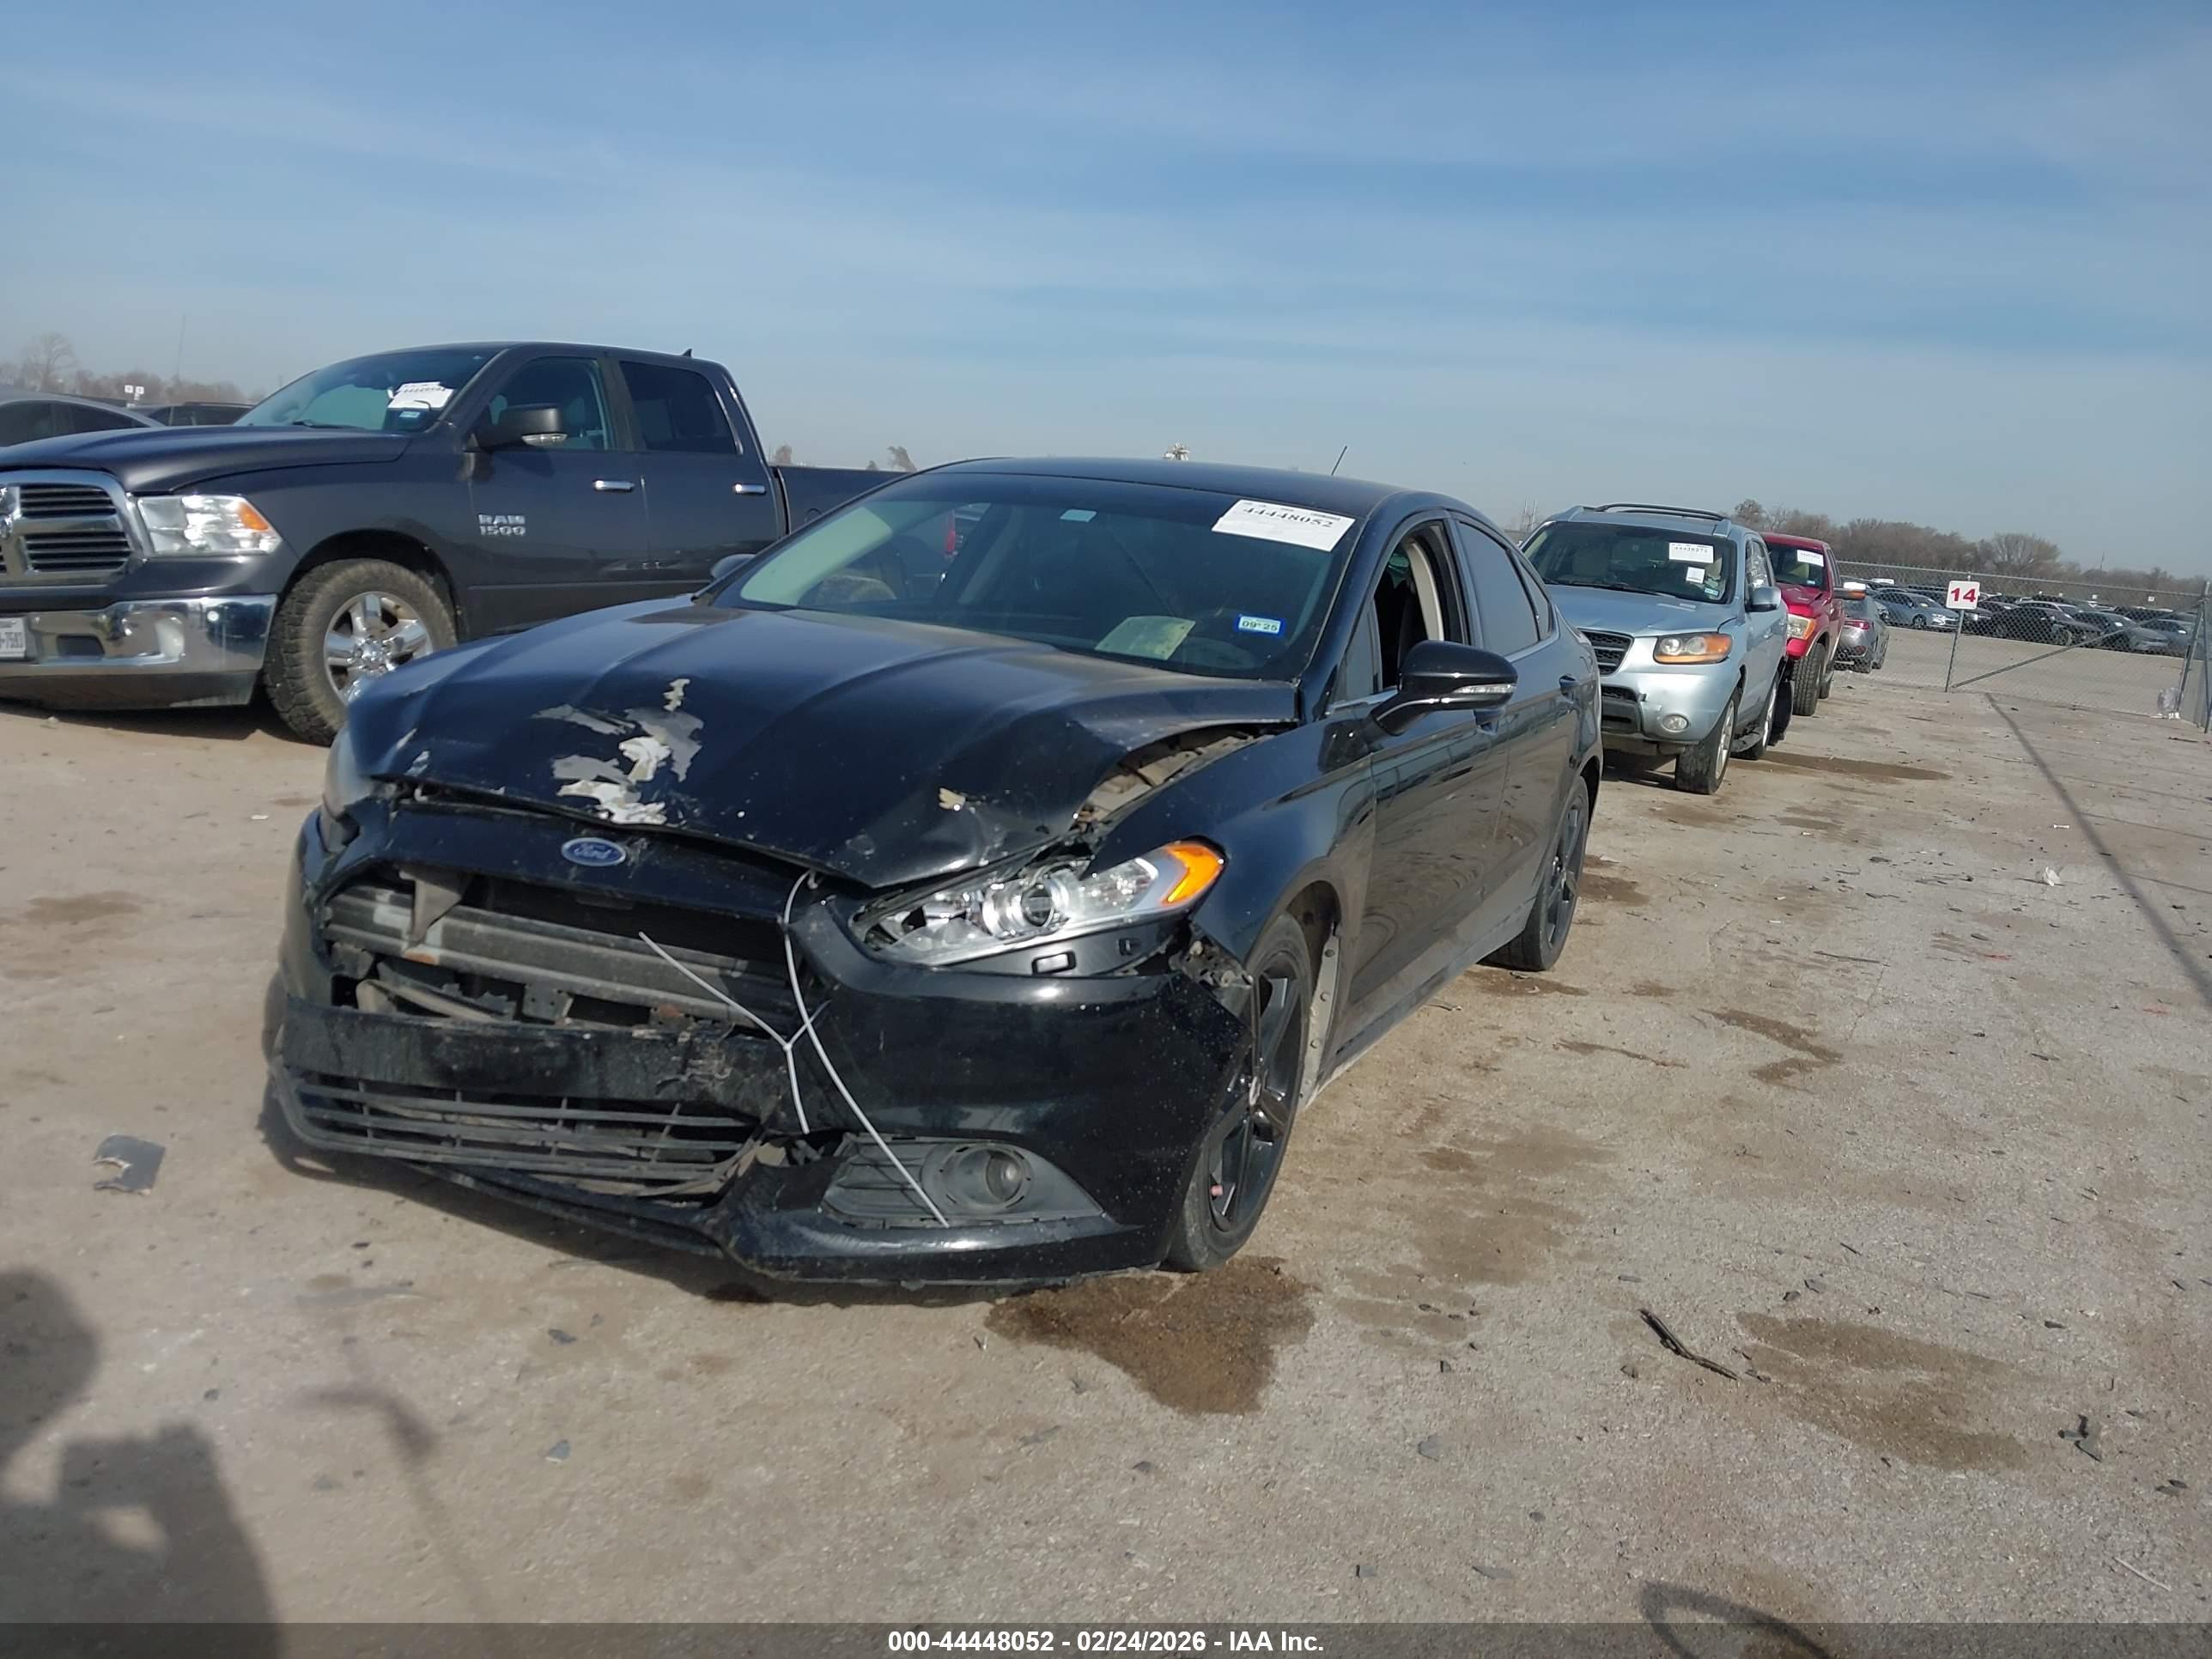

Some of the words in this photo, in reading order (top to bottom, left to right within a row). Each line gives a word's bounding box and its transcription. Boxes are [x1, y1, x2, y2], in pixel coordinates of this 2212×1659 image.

[478, 514, 526, 525] RAM
[1243, 507, 1334, 528] 44448052
[479, 525, 526, 536] 1500
[1951, 587, 1976, 603] 14
[572, 842, 612, 860] Ford
